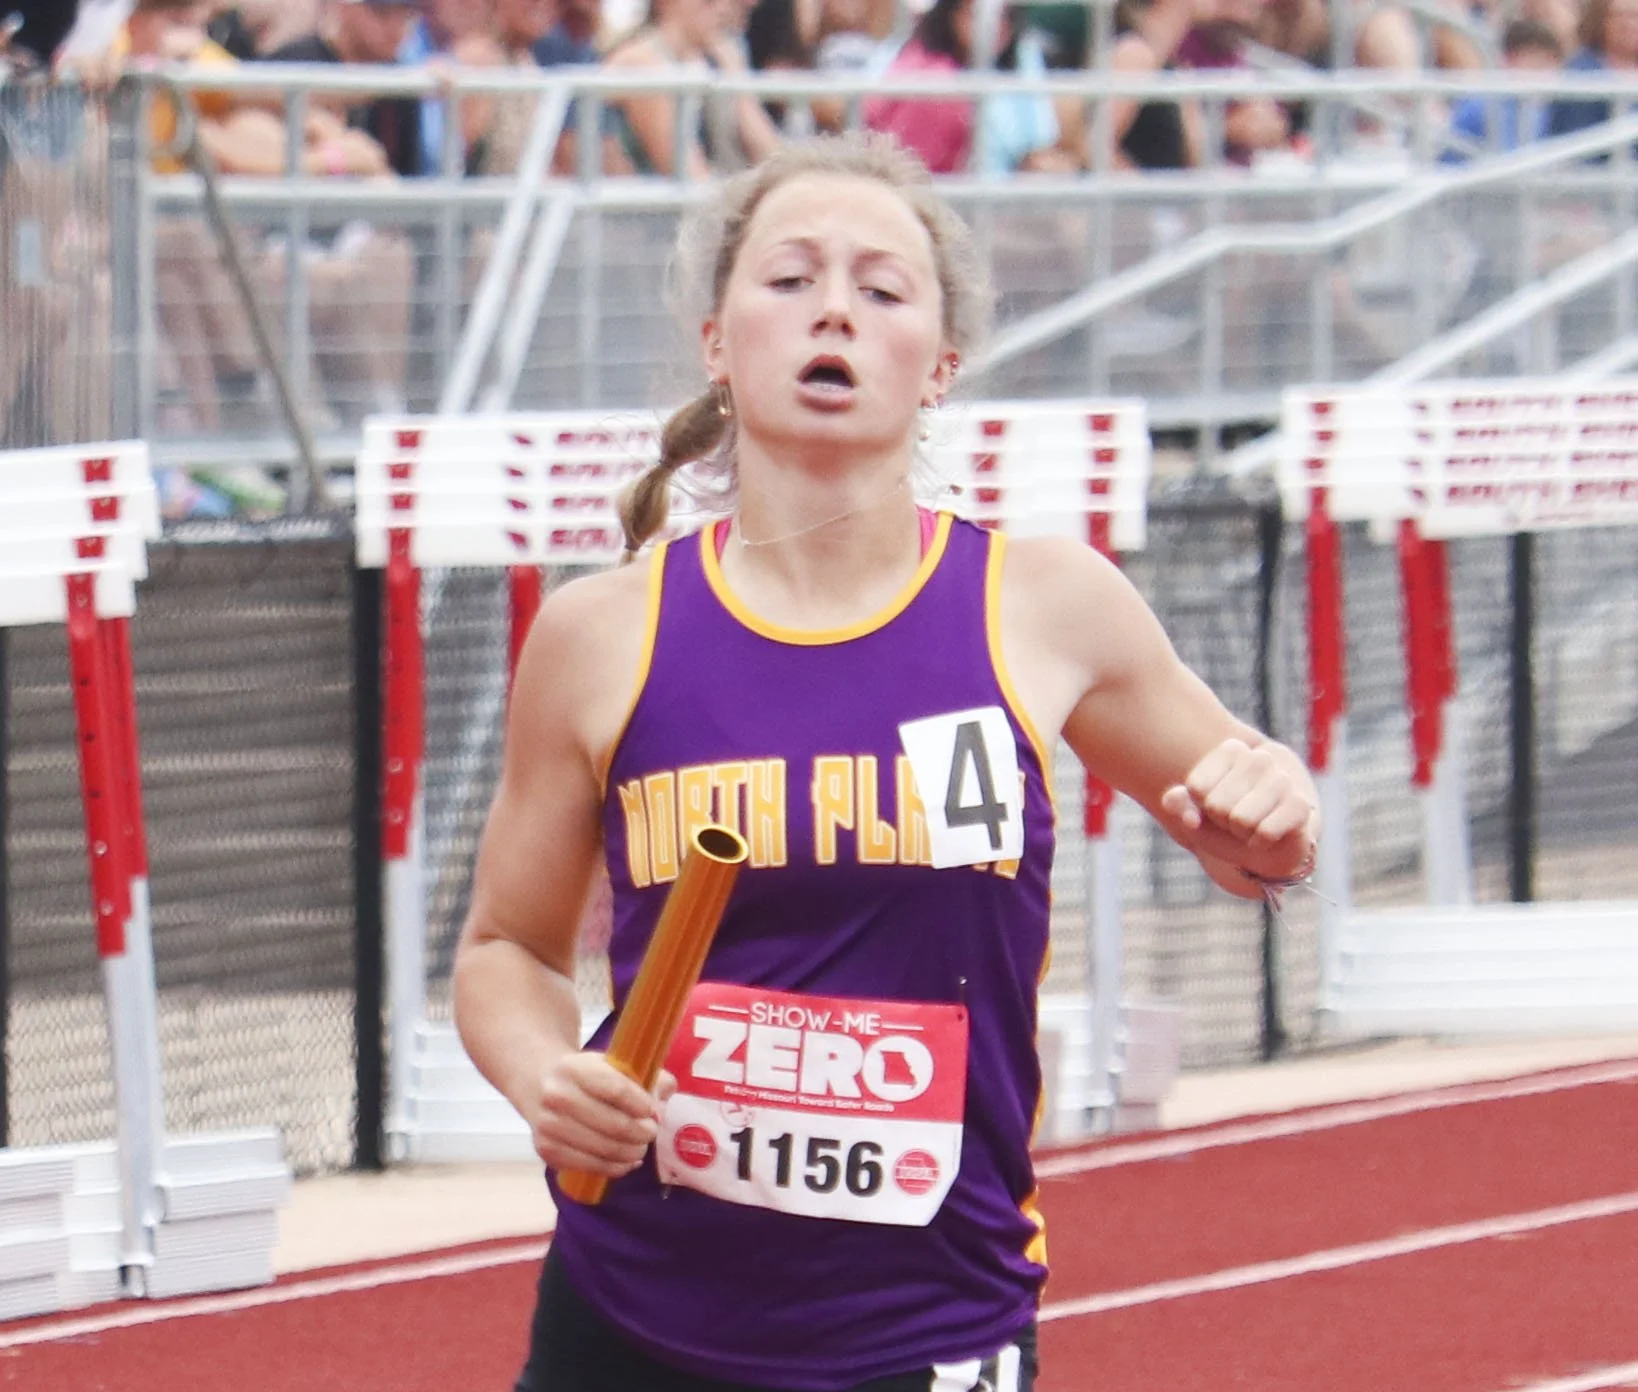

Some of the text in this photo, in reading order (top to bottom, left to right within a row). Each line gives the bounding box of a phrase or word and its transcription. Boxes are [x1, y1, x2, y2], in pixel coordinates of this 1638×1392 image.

[617, 757, 788, 889] NORTH
[944, 720, 1009, 852] 4
[691, 1015, 934, 1102] ZERO
[751, 1002, 881, 1036] SHOW-ME
[730, 1126, 884, 1198] 1156
